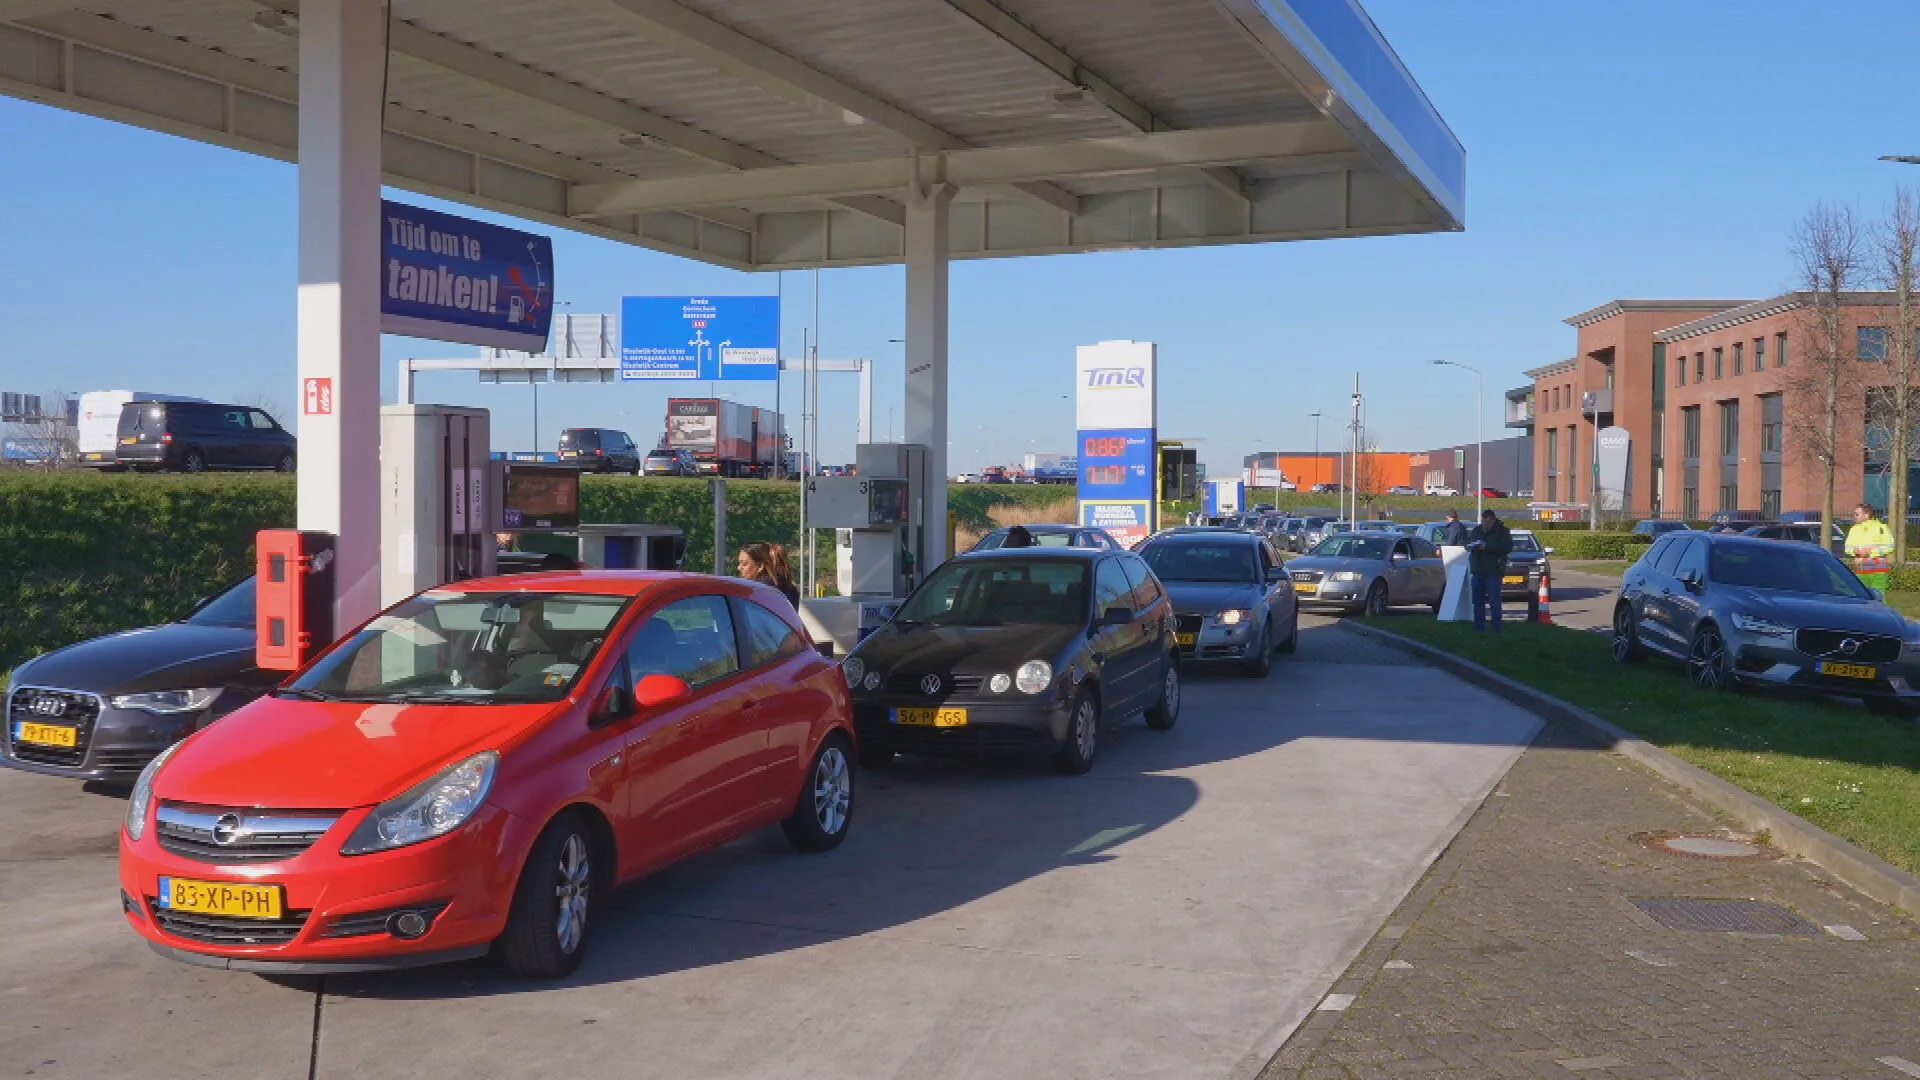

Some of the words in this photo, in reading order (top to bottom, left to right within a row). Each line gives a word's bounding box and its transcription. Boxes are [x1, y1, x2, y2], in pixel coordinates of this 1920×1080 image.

[388, 217, 426, 251] Tijd
[430, 231, 459, 257] om
[462, 235, 481, 261] te
[388, 258, 498, 313] tanken!
[808, 481, 817, 493] 4
[859, 481, 868, 495] 3
[175, 883, 270, 913] 83-XP-PH
